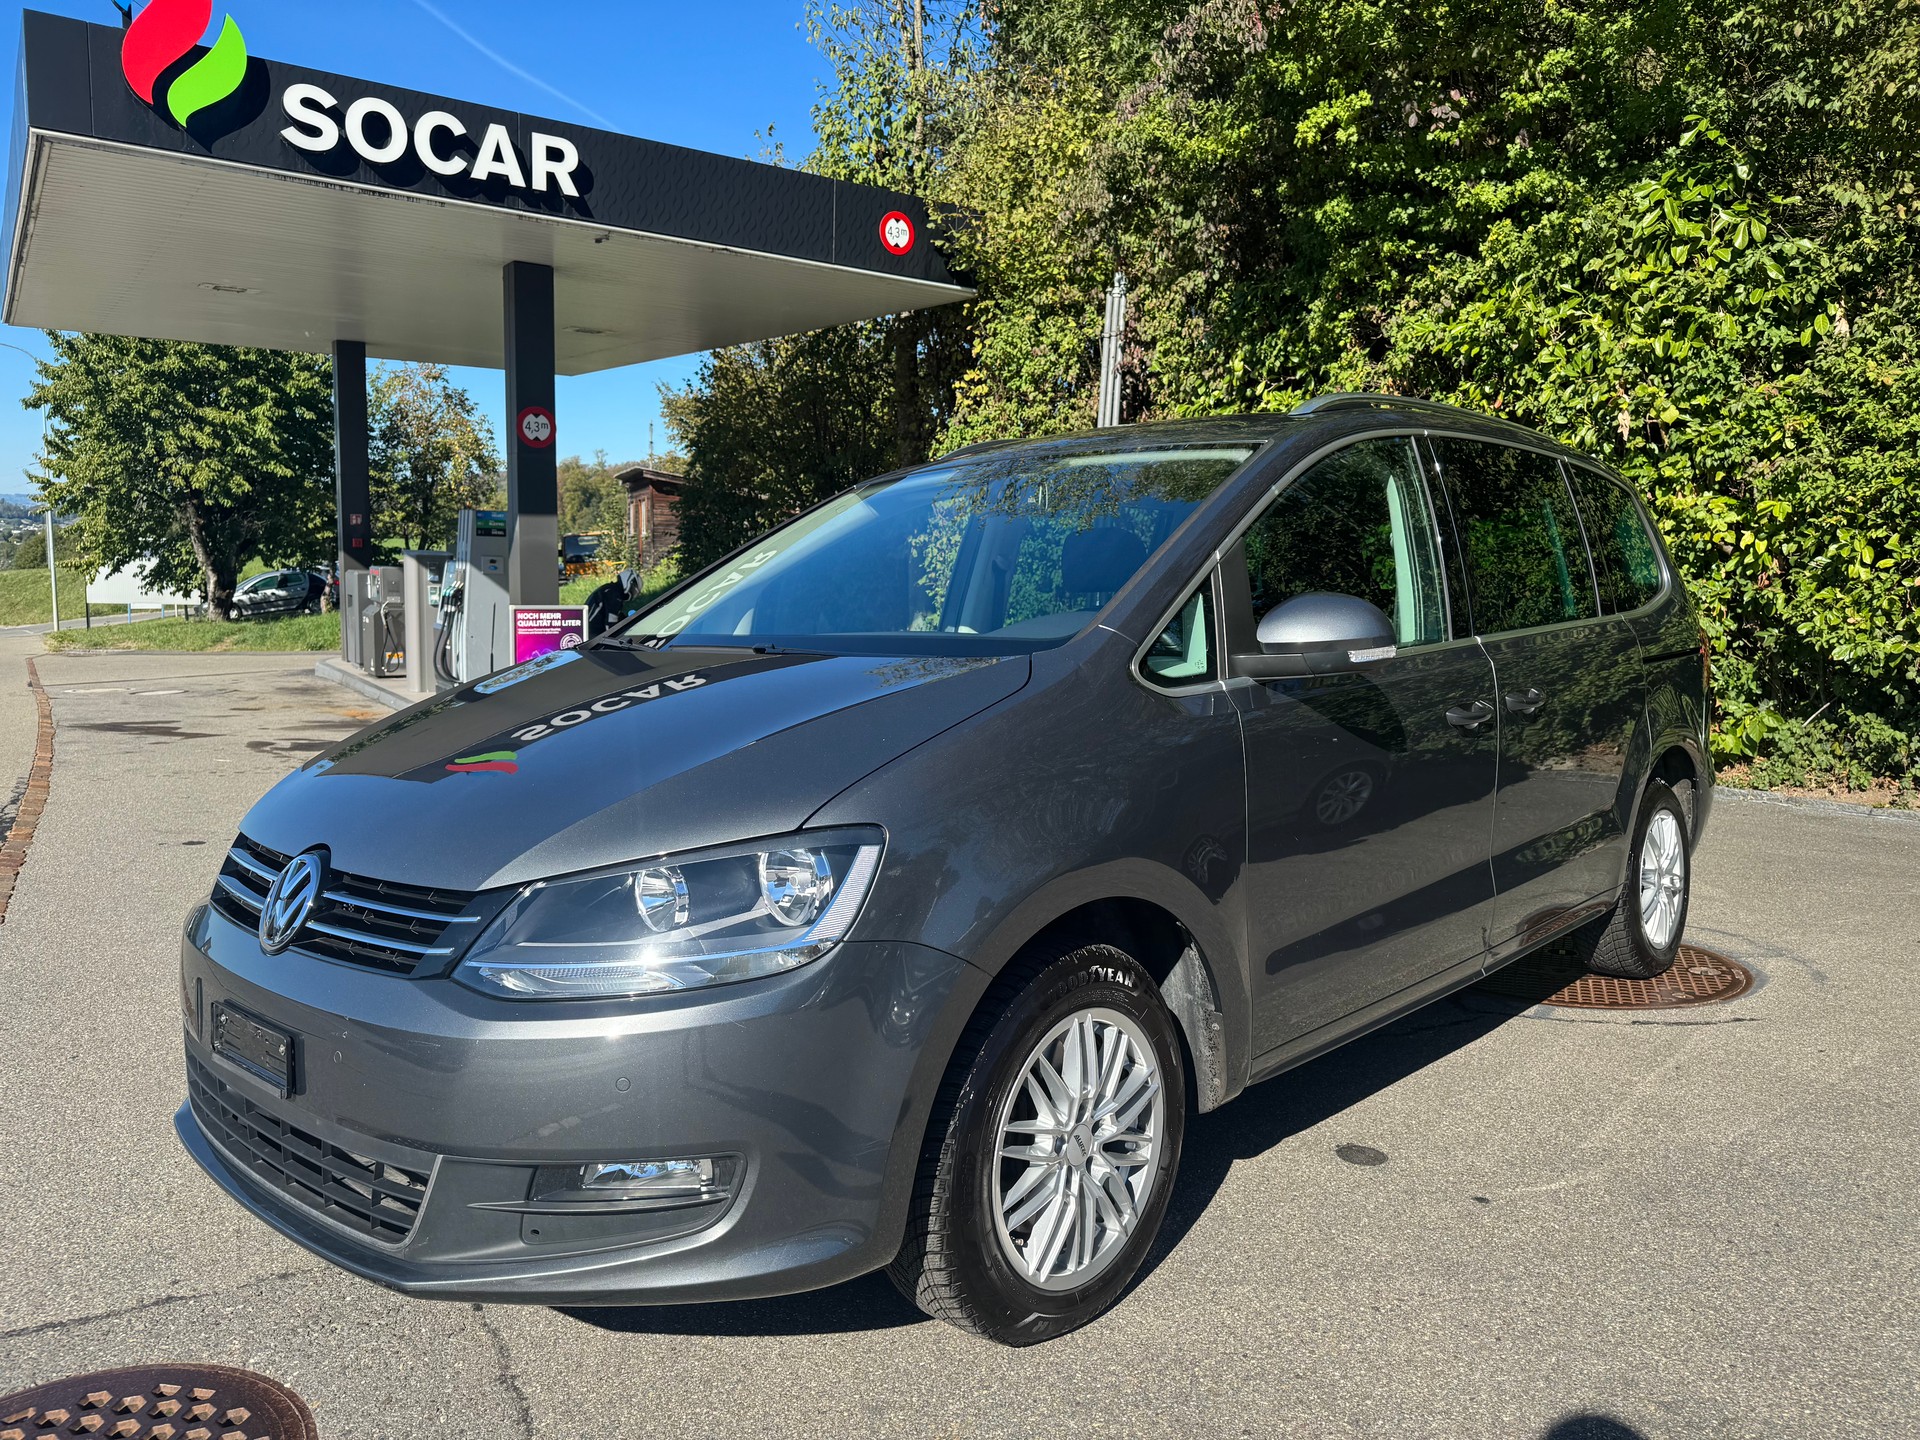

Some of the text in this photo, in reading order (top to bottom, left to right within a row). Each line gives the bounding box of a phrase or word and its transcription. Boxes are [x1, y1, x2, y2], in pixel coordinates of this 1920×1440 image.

[280, 83, 580, 198] SOCAR
[524, 420, 549, 434] 4,3m
[517, 619, 581, 627] QUALITÄT IM LITER
